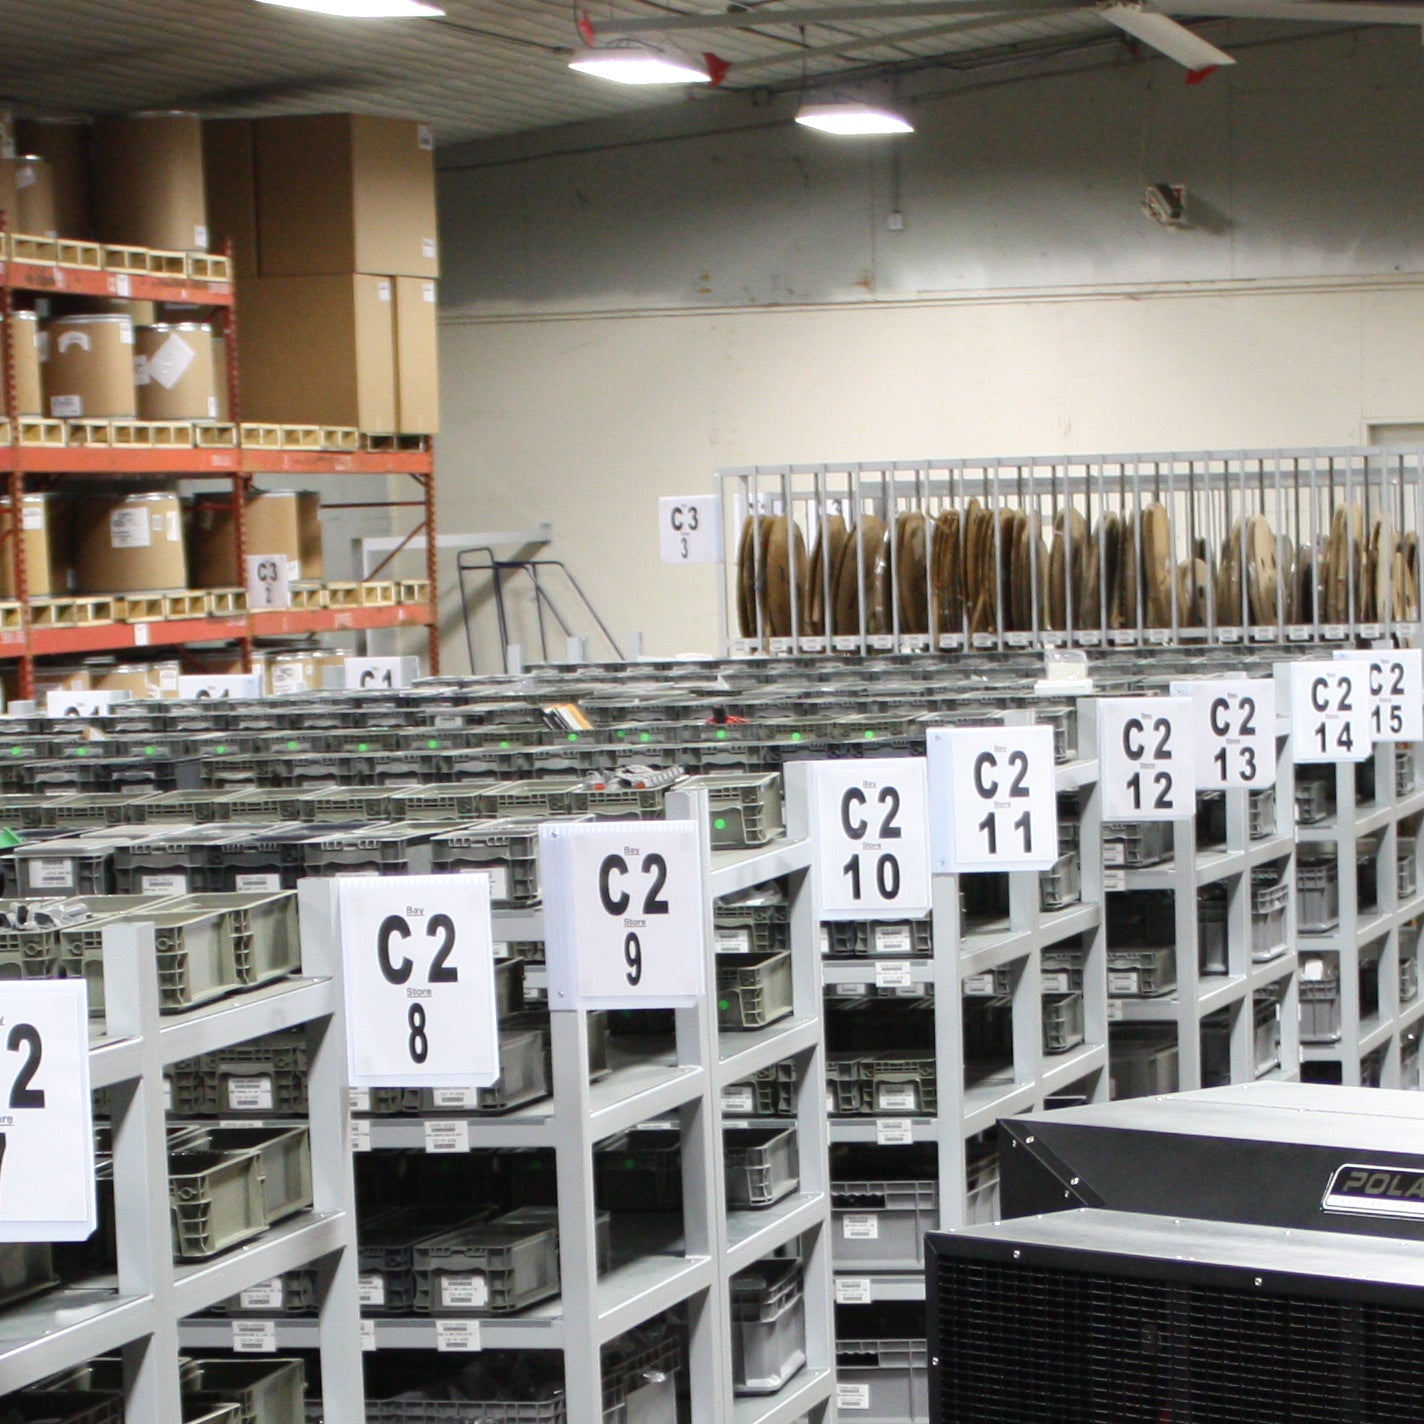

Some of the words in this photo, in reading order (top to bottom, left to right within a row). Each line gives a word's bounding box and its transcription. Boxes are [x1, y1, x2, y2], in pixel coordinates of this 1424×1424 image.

[680, 537, 688, 560] 3
[1370, 705, 1403, 734] 15
[1314, 720, 1354, 753] 14
[1213, 746, 1257, 782] 13
[1126, 771, 1174, 810] 12
[978, 810, 1033, 855] 11
[623, 846, 641, 856] Bay
[842, 852, 901, 901] 10
[406, 905, 425, 917] Bay
[623, 918, 647, 928] Store
[624, 931, 643, 987] 9
[406, 987, 432, 998] Store
[407, 1001, 429, 1065] 8
